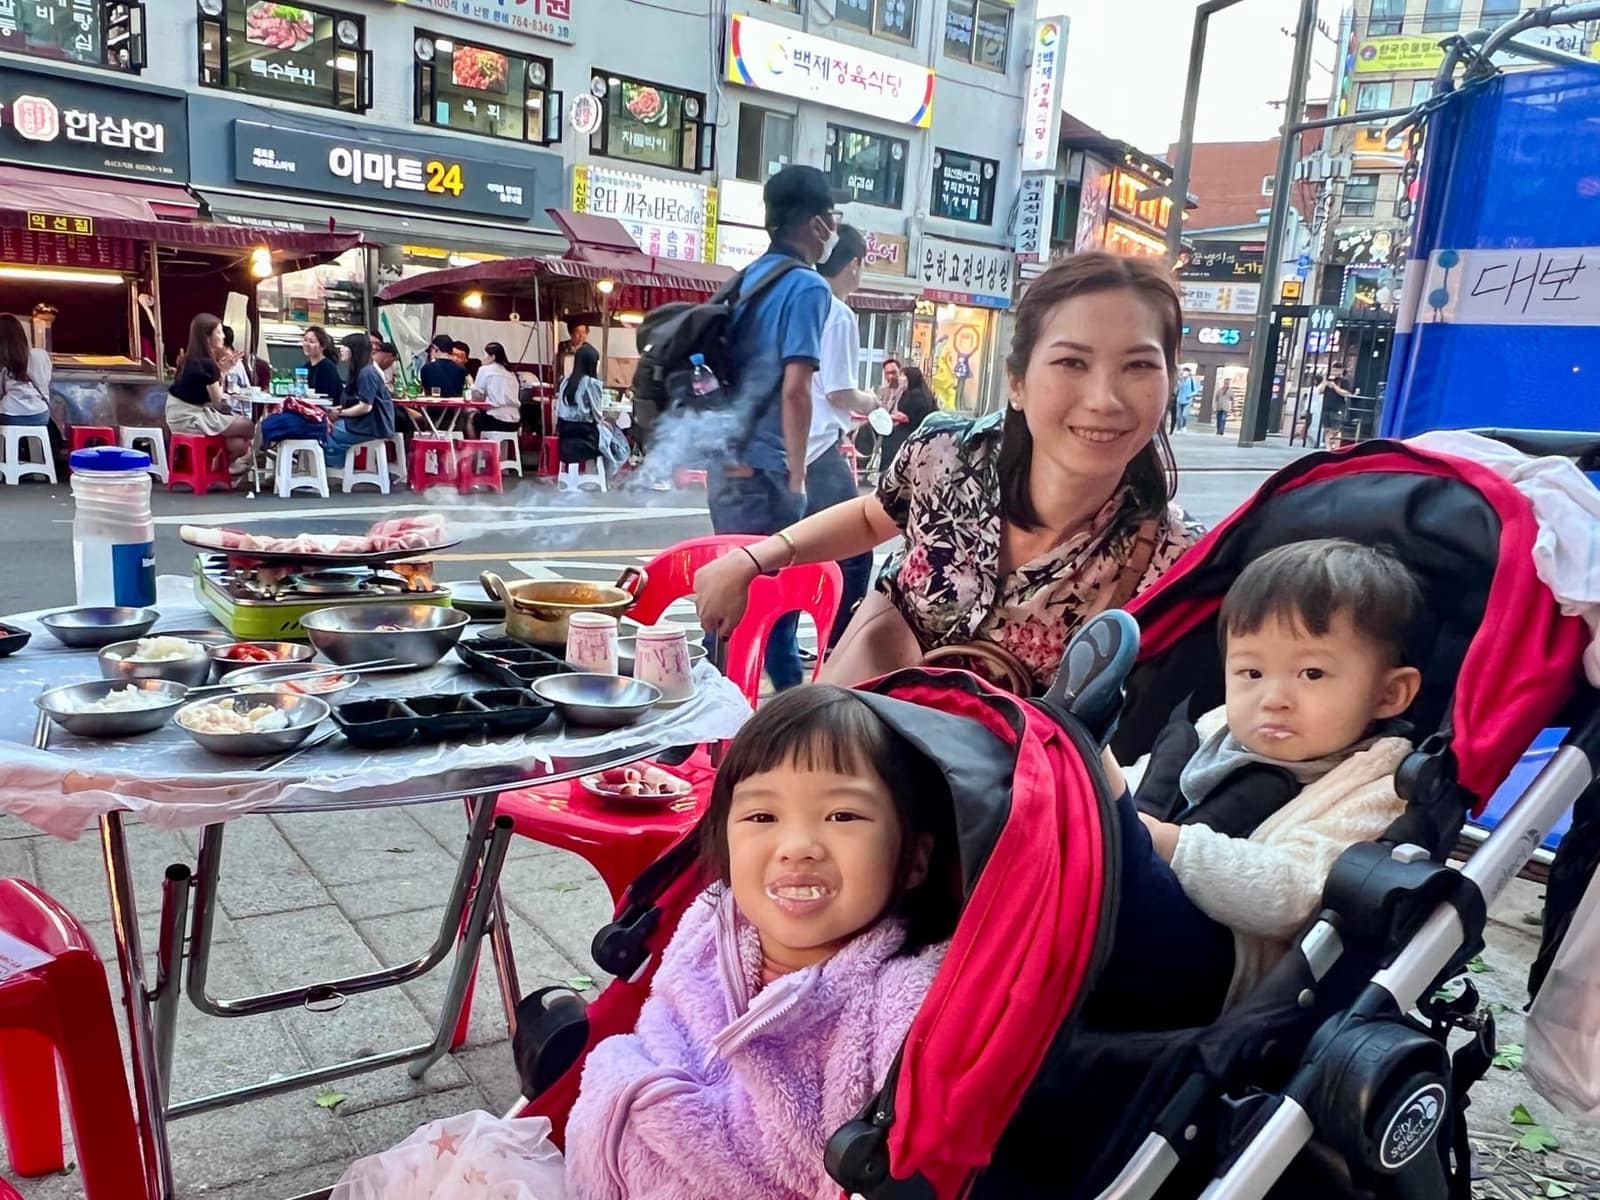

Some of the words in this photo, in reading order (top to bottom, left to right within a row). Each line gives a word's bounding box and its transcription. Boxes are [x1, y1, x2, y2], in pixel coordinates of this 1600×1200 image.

[793, 49, 902, 98] 백제정육식당
[64, 110, 165, 153] 한삼인
[329, 148, 464, 197] 이마트24
[576, 183, 586, 213] 신생
[1020, 192, 1040, 251] 고전의상실
[667, 230, 679, 258] 손금
[923, 248, 1010, 293] 은하고전의상실
[1198, 327, 1240, 345] GS25
